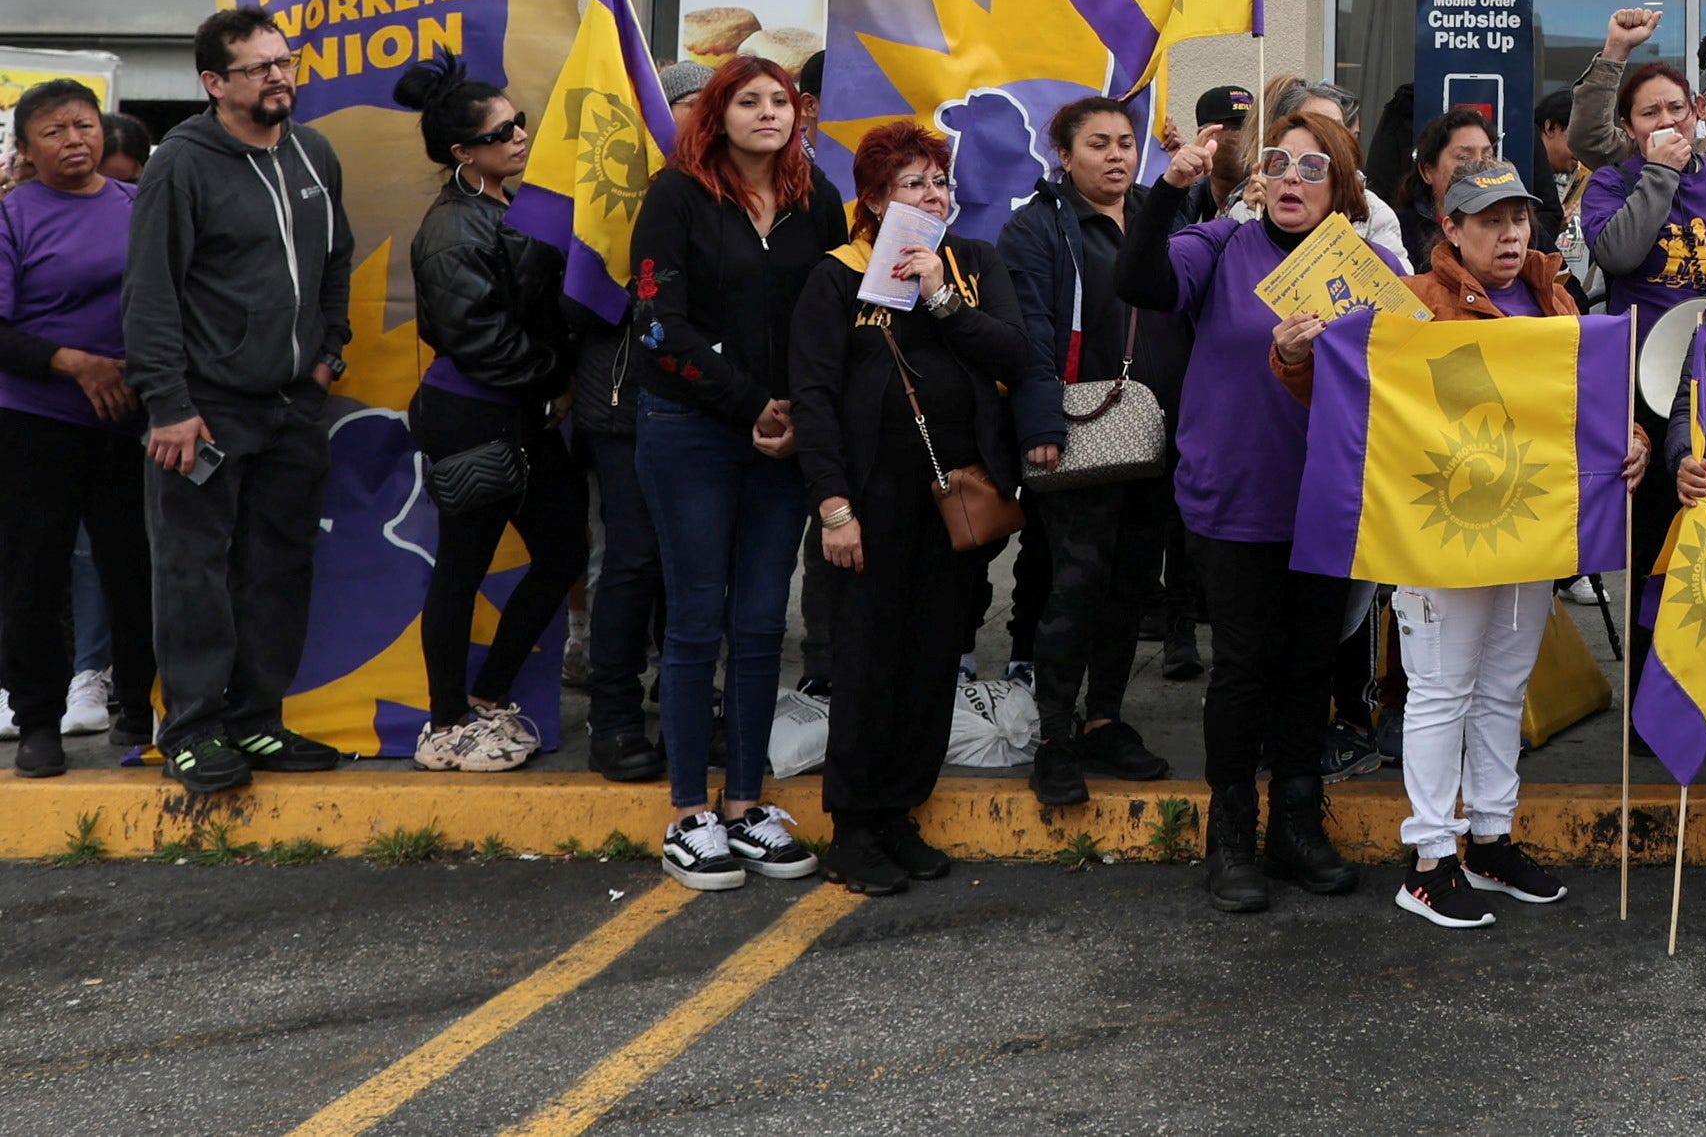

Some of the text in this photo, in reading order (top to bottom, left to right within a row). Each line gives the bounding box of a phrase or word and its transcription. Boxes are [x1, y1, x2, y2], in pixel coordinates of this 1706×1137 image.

[1427, 10, 1521, 29] Curbside
[295, 12, 463, 86] NION
[1434, 32, 1515, 53] Pick Up
